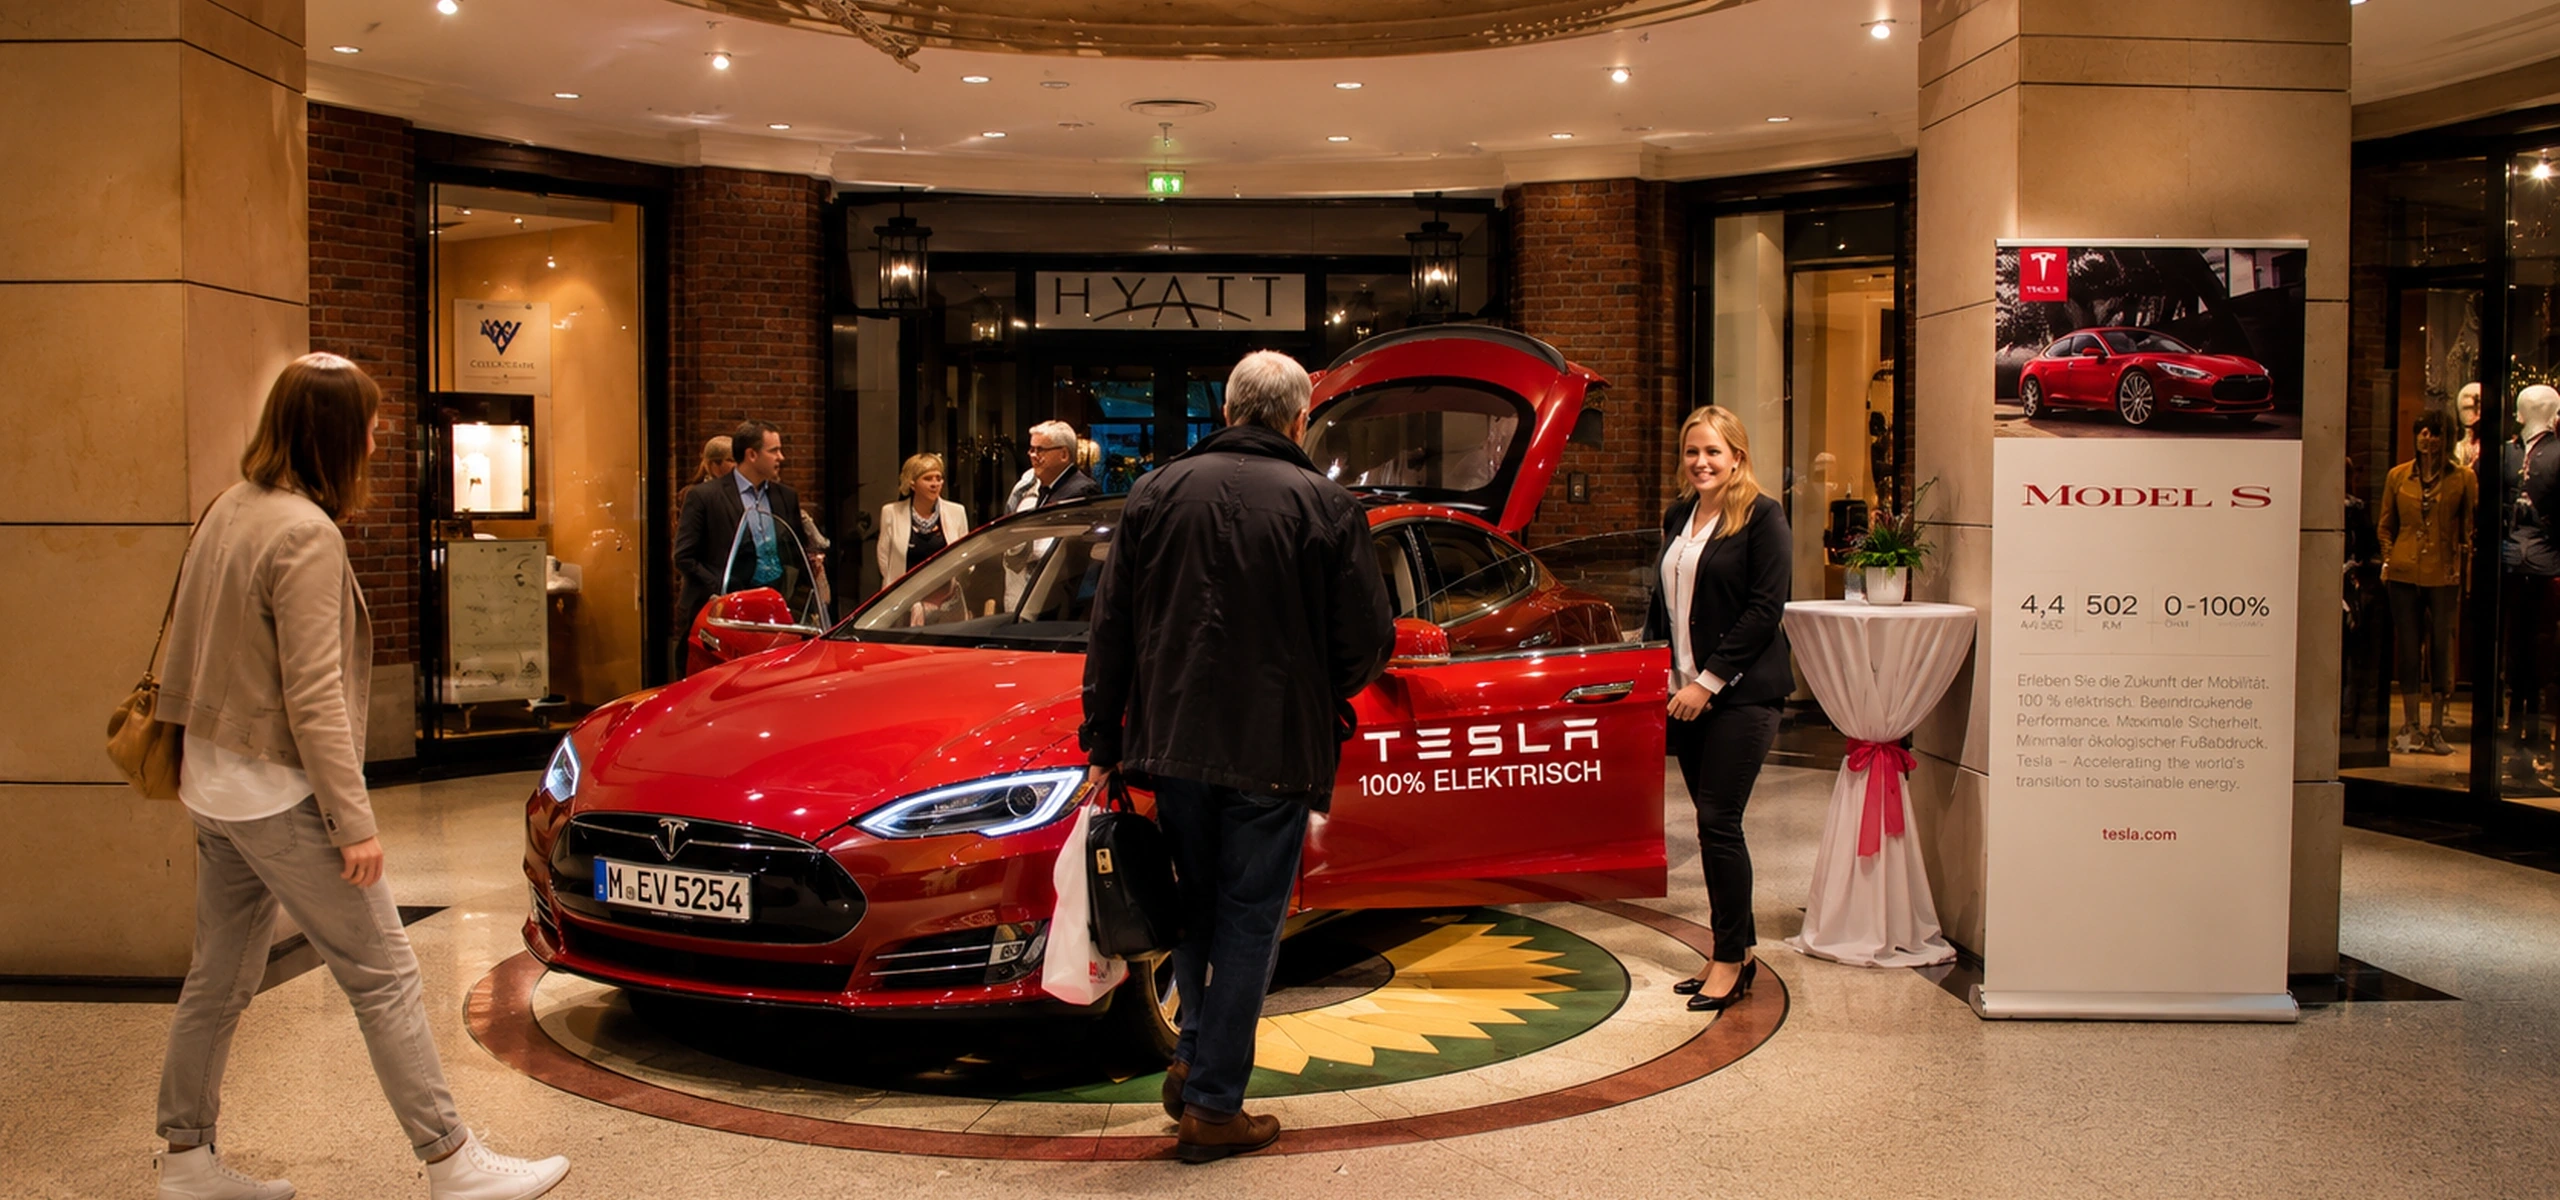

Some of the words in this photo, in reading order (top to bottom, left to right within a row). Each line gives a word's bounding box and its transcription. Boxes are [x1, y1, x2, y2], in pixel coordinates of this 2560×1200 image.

[1055, 276, 1281, 328] HYATT
[2021, 484, 2212, 508] MODEL
[2230, 486, 2272, 509] S
[2020, 594, 2065, 619] 4,4
[2086, 595, 2138, 616] 502
[2017, 673, 2071, 688] Erleben
[2074, 674, 2097, 688] Sie
[2124, 674, 2177, 689] Zukunft
[2180, 676, 2204, 689] der
[2018, 693, 2043, 707] 100
[2046, 694, 2061, 708] %
[1364, 718, 1599, 763] TESLA
[2016, 754, 2053, 768] Tesla
[2167, 757, 2190, 770] the
[1358, 770, 1426, 797] 100%
[1434, 760, 1602, 792] ELEKTRISCH
[2016, 775, 2081, 788] transition
[2086, 776, 2100, 788] to
[2104, 775, 2185, 790] sustainable
[2188, 777, 2241, 793] energy.
[2102, 827, 2178, 841] tesla.com
[674, 874, 743, 914] 5254
